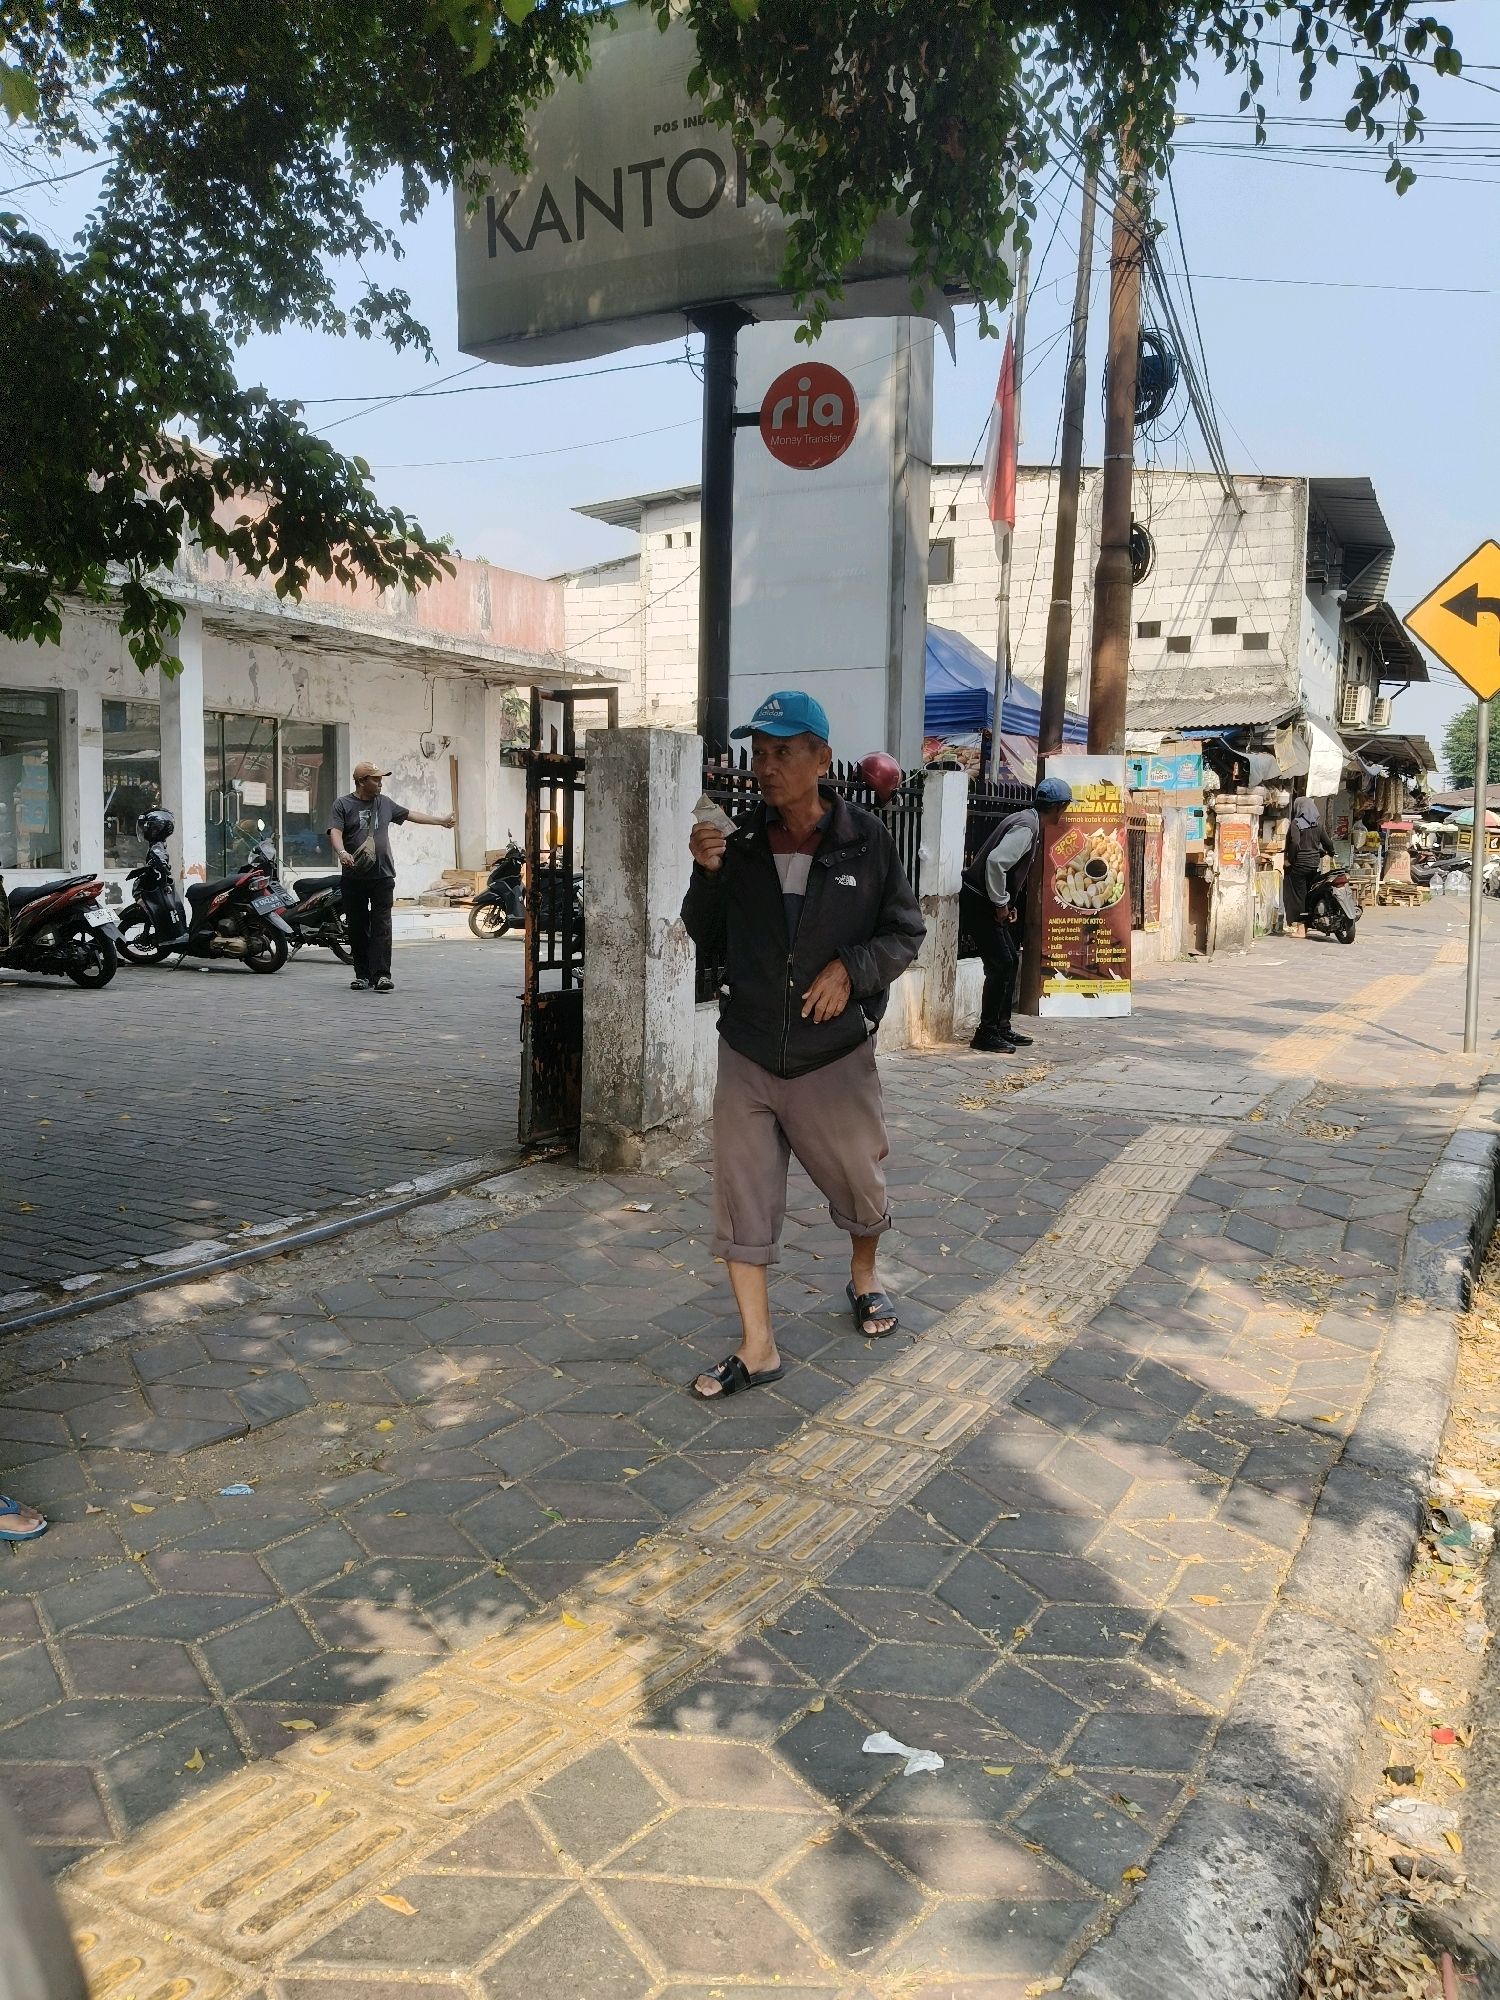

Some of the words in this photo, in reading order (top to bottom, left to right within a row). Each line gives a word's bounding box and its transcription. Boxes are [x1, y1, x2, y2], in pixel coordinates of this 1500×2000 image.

[653, 119, 679, 136] POS
[771, 376, 844, 430] ria
[770, 435, 803, 447] Money
[803, 432, 841, 444] Transfer
[1071, 785, 1122, 801] EMPEK
[1054, 831, 1078, 855] 3PCS
[1061, 841, 1080, 860] 10K
